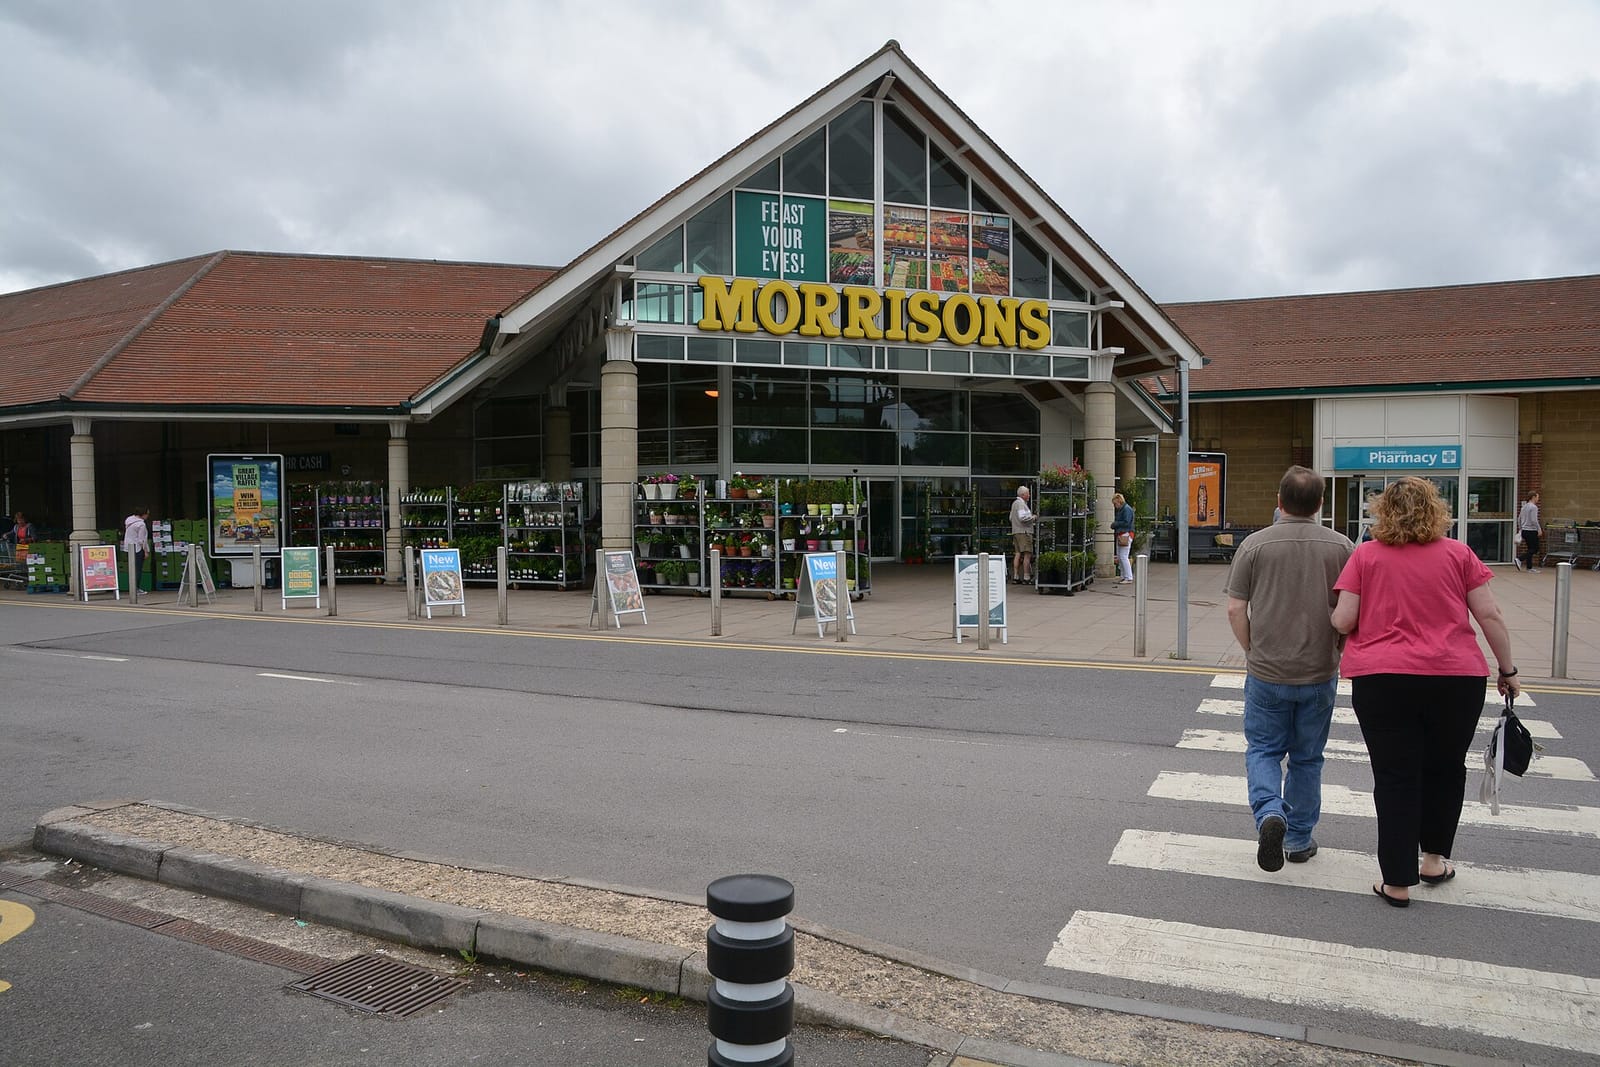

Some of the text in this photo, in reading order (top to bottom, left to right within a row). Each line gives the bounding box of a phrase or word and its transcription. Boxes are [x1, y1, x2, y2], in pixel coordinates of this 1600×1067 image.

[761, 201, 806, 225] FEAST
[761, 225, 803, 250] YOUR
[762, 250, 805, 274] EYES!
[698, 276, 1052, 350] MORRISONS
[299, 456, 322, 469] CASH
[1369, 451, 1438, 466] Pharmacy
[428, 554, 454, 565] New
[813, 559, 836, 571] New
